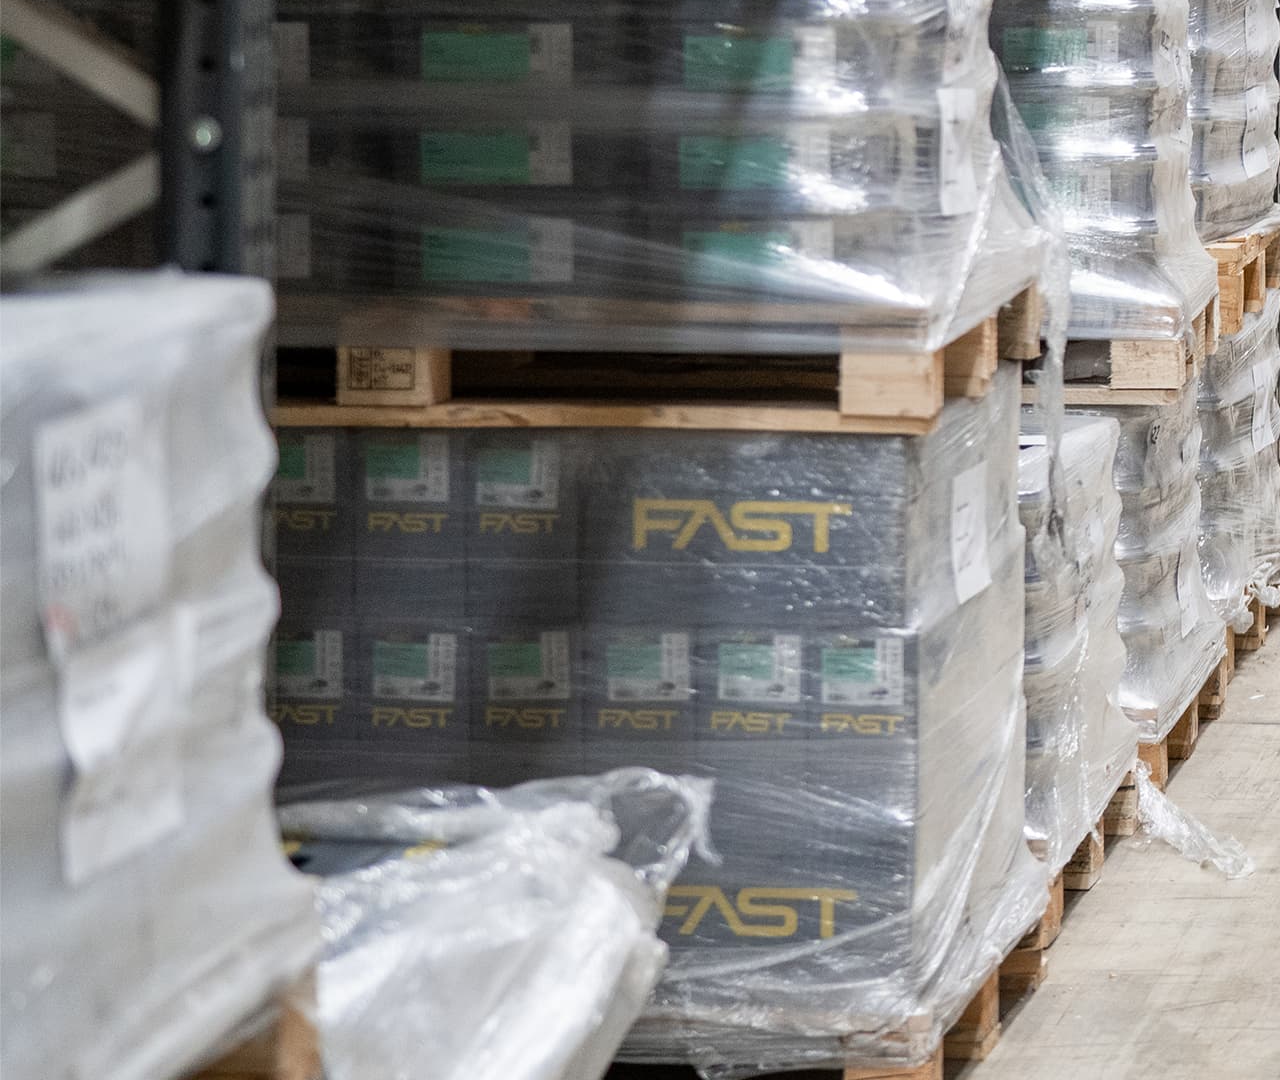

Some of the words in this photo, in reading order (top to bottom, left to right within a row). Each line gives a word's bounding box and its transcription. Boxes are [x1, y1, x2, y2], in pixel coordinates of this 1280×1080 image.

[367, 511, 450, 535] FAST
[479, 512, 562, 536] FAST
[632, 496, 853, 553] FAST
[371, 706, 455, 729] FAST
[484, 707, 567, 730] FAST
[597, 708, 680, 731] FAST
[710, 710, 792, 735] FAST
[821, 713, 905, 735] FAST
